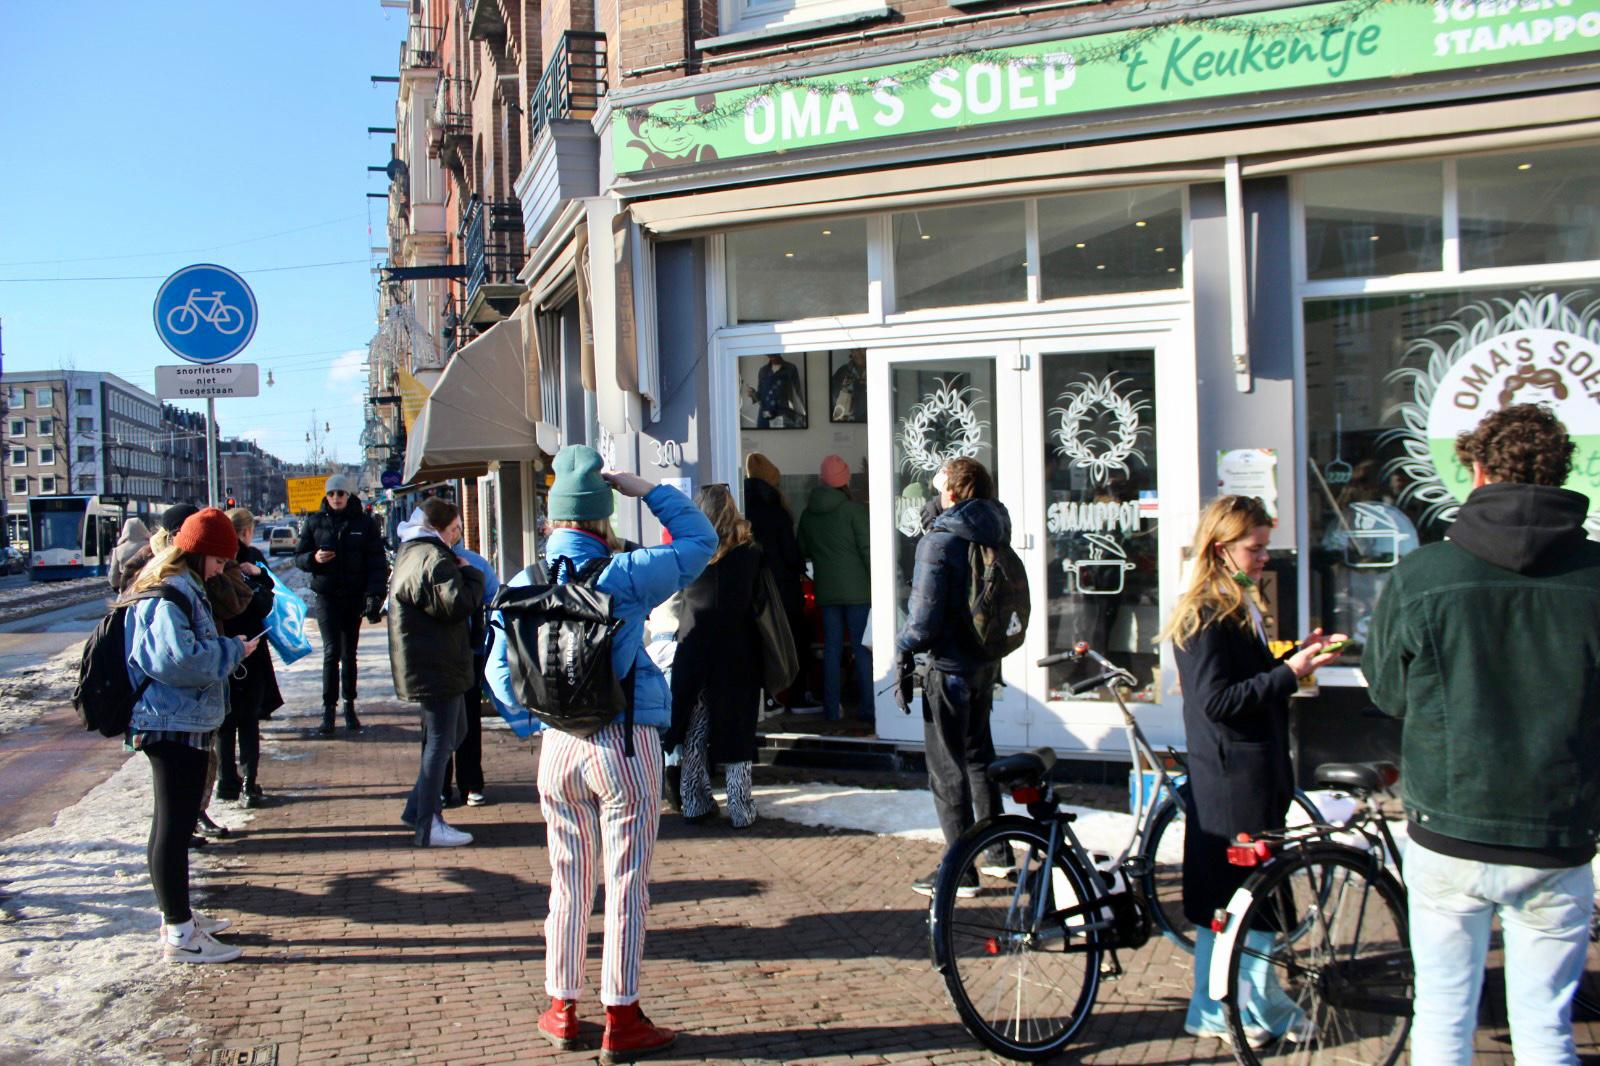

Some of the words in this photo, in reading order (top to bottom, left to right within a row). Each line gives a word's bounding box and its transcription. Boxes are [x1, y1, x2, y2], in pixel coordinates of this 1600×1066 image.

[1161, 24, 1382, 90] Keukentje
[1433, 11, 1600, 57] STAMPPO
[744, 77, 905, 145] OMAS
[928, 52, 1077, 119] SOEP
[180, 386, 234, 395] toegestaan
[196, 377, 216, 385] niet
[1453, 337, 1534, 410] OMA'S
[649, 439, 676, 465] 30
